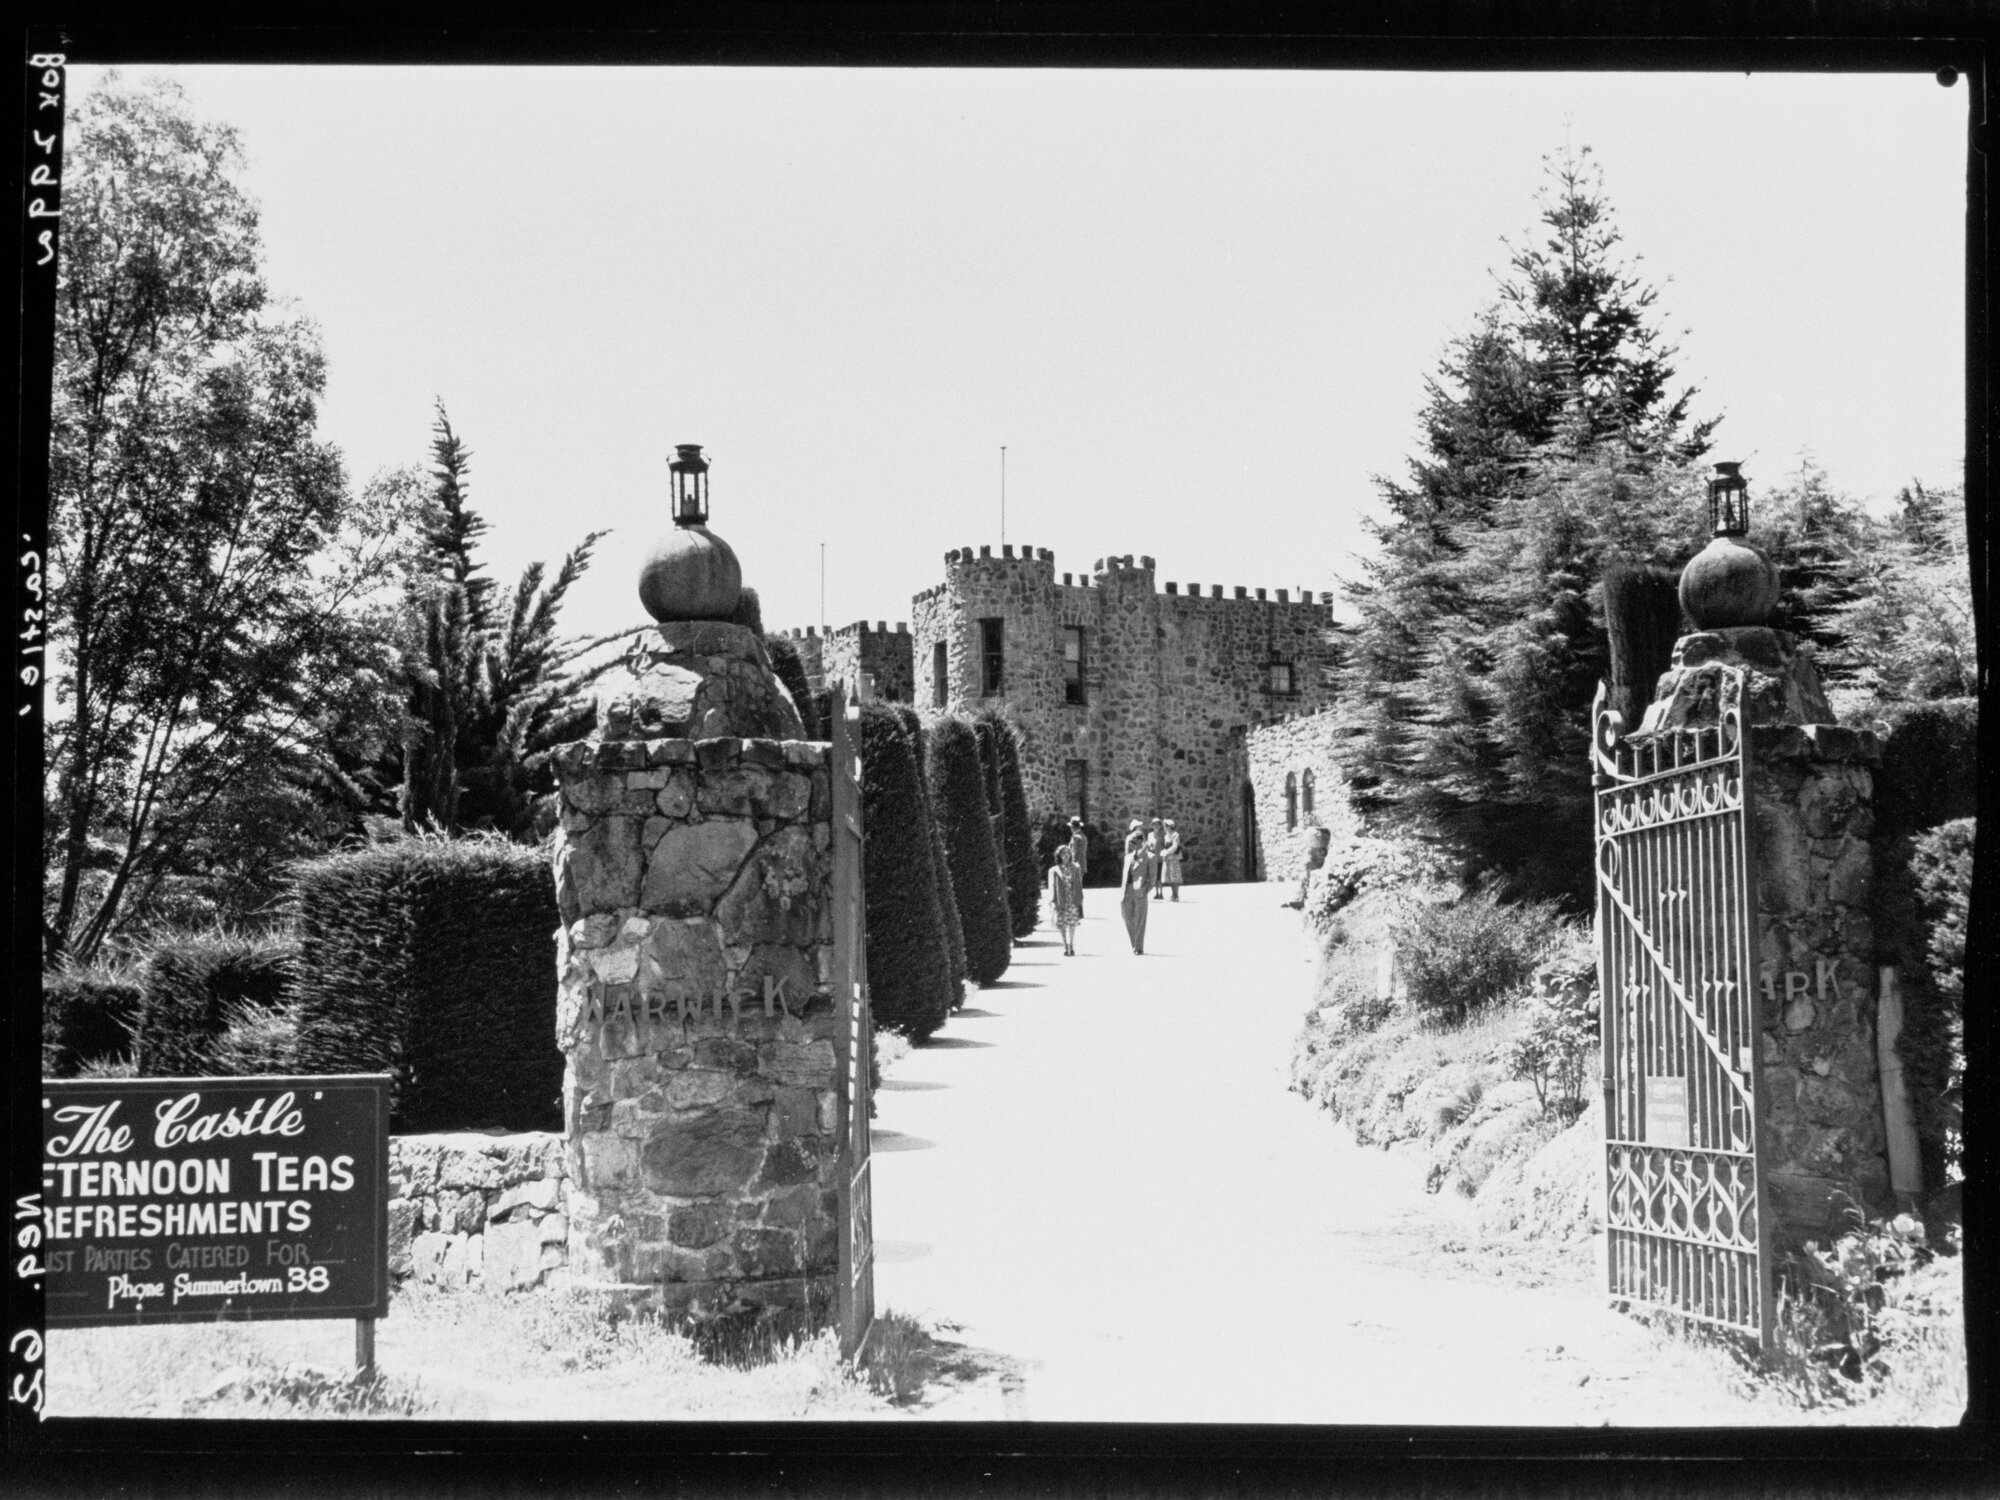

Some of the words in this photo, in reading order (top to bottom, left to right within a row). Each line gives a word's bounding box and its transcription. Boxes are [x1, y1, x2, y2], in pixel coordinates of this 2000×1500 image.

[252, 1151, 355, 1192] TEAS
[84, 1244, 152, 1273] PARTIES
[166, 1242, 250, 1270] CATERED
[267, 1239, 310, 1267] FOR
[108, 1273, 165, 1310] Phone
[173, 1272, 283, 1306] Summertown
[287, 1265, 330, 1294] 38
